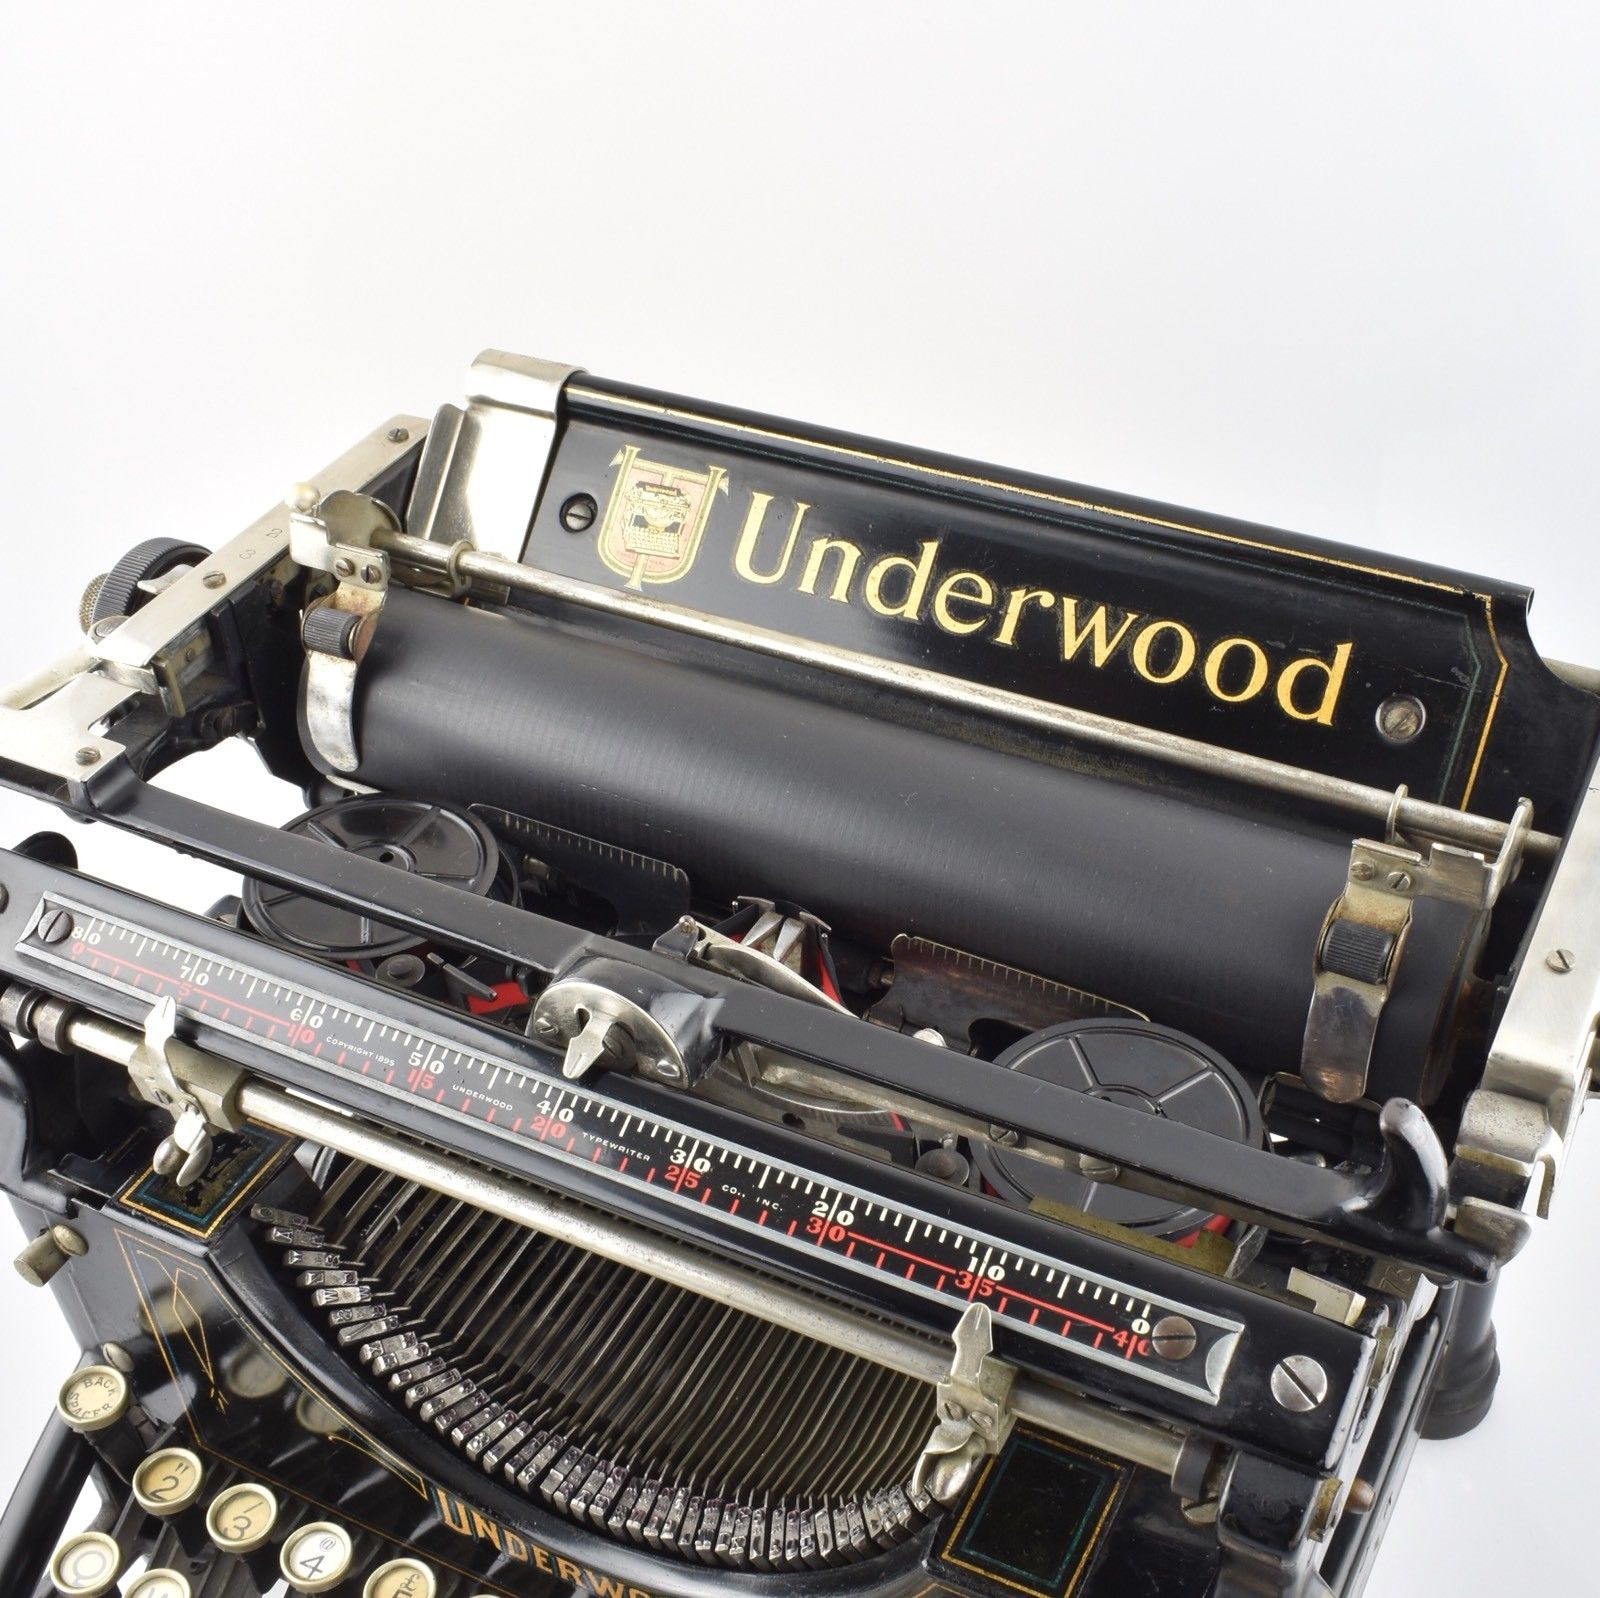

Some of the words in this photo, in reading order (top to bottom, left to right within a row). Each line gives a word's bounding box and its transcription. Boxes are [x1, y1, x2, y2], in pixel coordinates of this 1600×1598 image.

[735, 490, 1354, 727] Underwood
[326, 1036, 374, 1057] COPYRIGHT
[453, 1084, 513, 1111] UNDERWOOD
[582, 1131, 651, 1162] TYPEWRITER
[756, 1196, 783, 1211] INC.
[180, 965, 209, 986] 70
[290, 1008, 323, 1028] 60
[408, 1051, 445, 1075] 50
[536, 1100, 574, 1123] 40
[669, 1149, 710, 1173] 30
[811, 1201, 854, 1226] 20
[967, 1257, 1005, 1281] 10
[1131, 1318, 1150, 1334] 0
[287, 1023, 315, 1044] 10
[407, 1068, 436, 1090] 15
[530, 1115, 567, 1138] 20
[664, 1165, 701, 1188] 25
[806, 1219, 845, 1241] 30
[955, 1271, 996, 1296] 35
[83, 1376, 117, 1397] BACK
[69, 1392, 112, 1419] SPACER
[150, 1475, 180, 1501] 2
[223, 1516, 252, 1540] 3
[300, 1555, 325, 1578] 4
